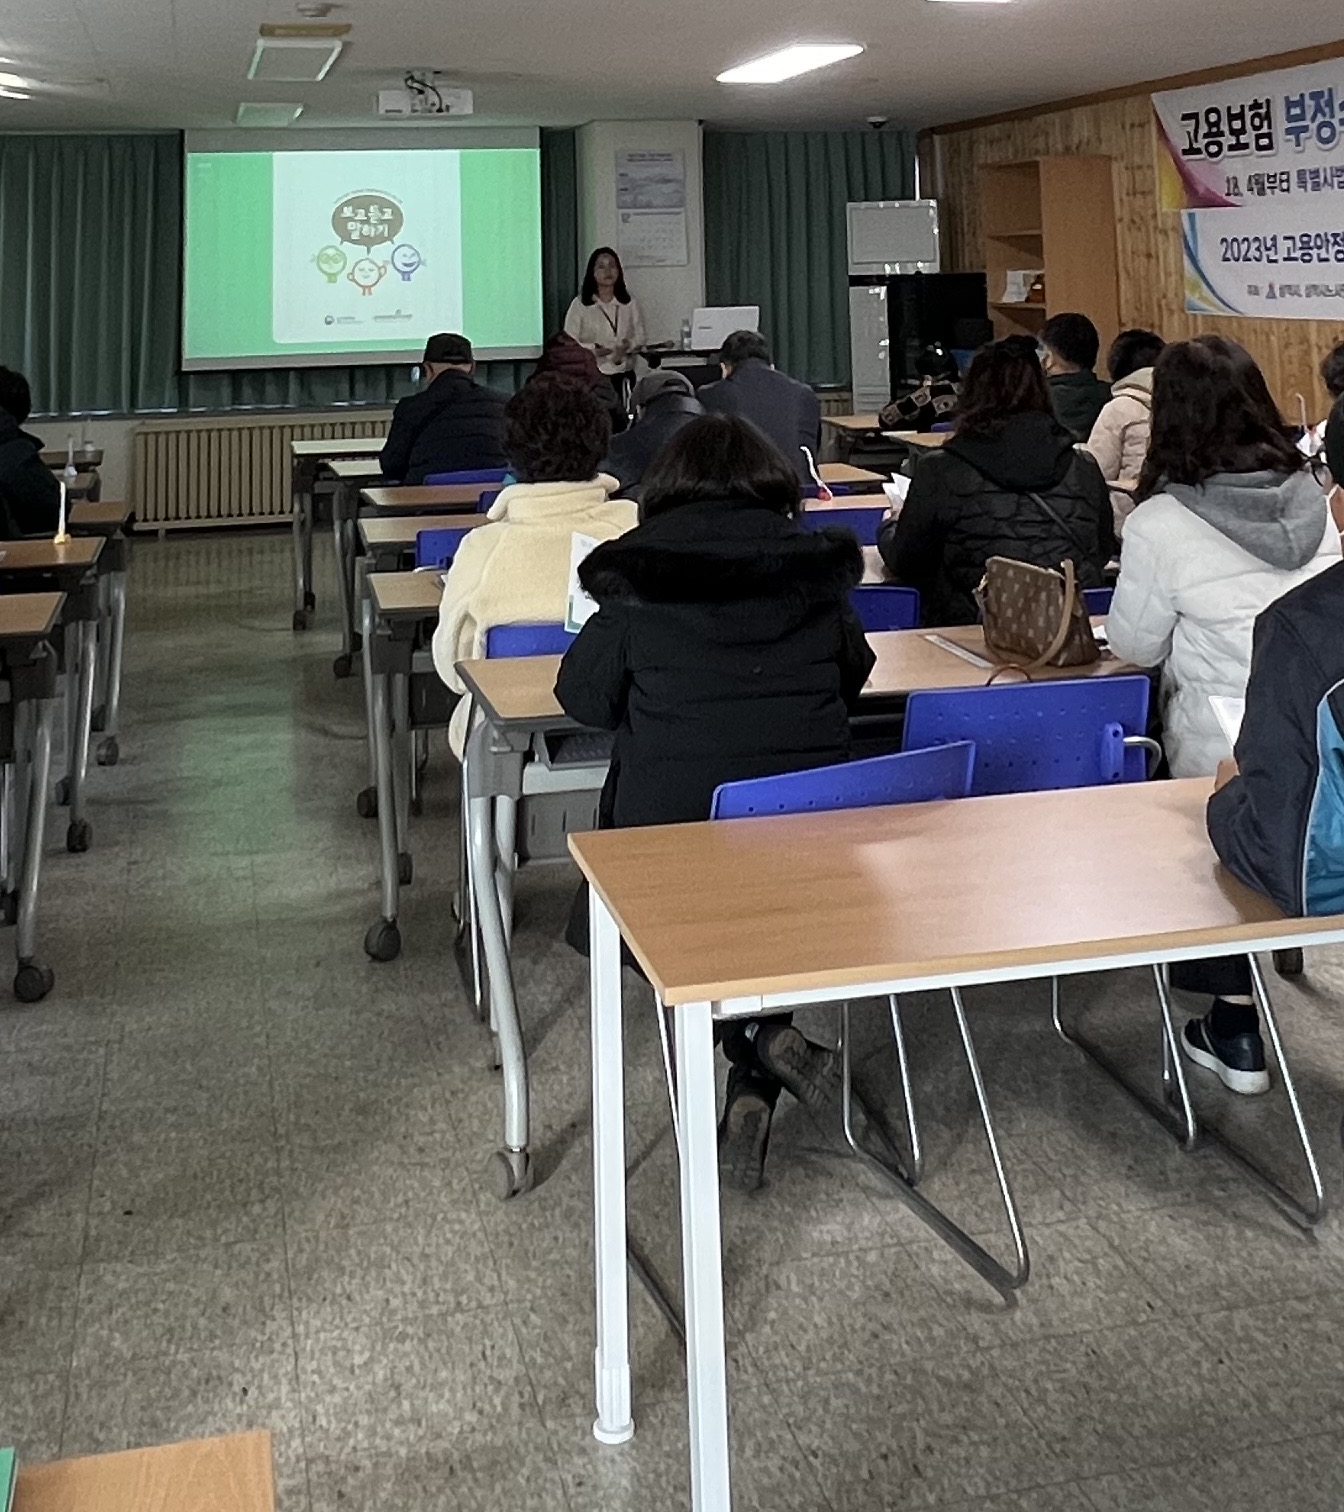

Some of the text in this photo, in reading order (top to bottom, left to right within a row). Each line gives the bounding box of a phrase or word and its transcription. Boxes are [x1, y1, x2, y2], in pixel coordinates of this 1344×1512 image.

[1181, 97, 1274, 158] 고용보험
[1246, 171, 1291, 197] 4월부터
[346, 221, 389, 240] 말하기
[1219, 234, 1279, 264] 2023년
